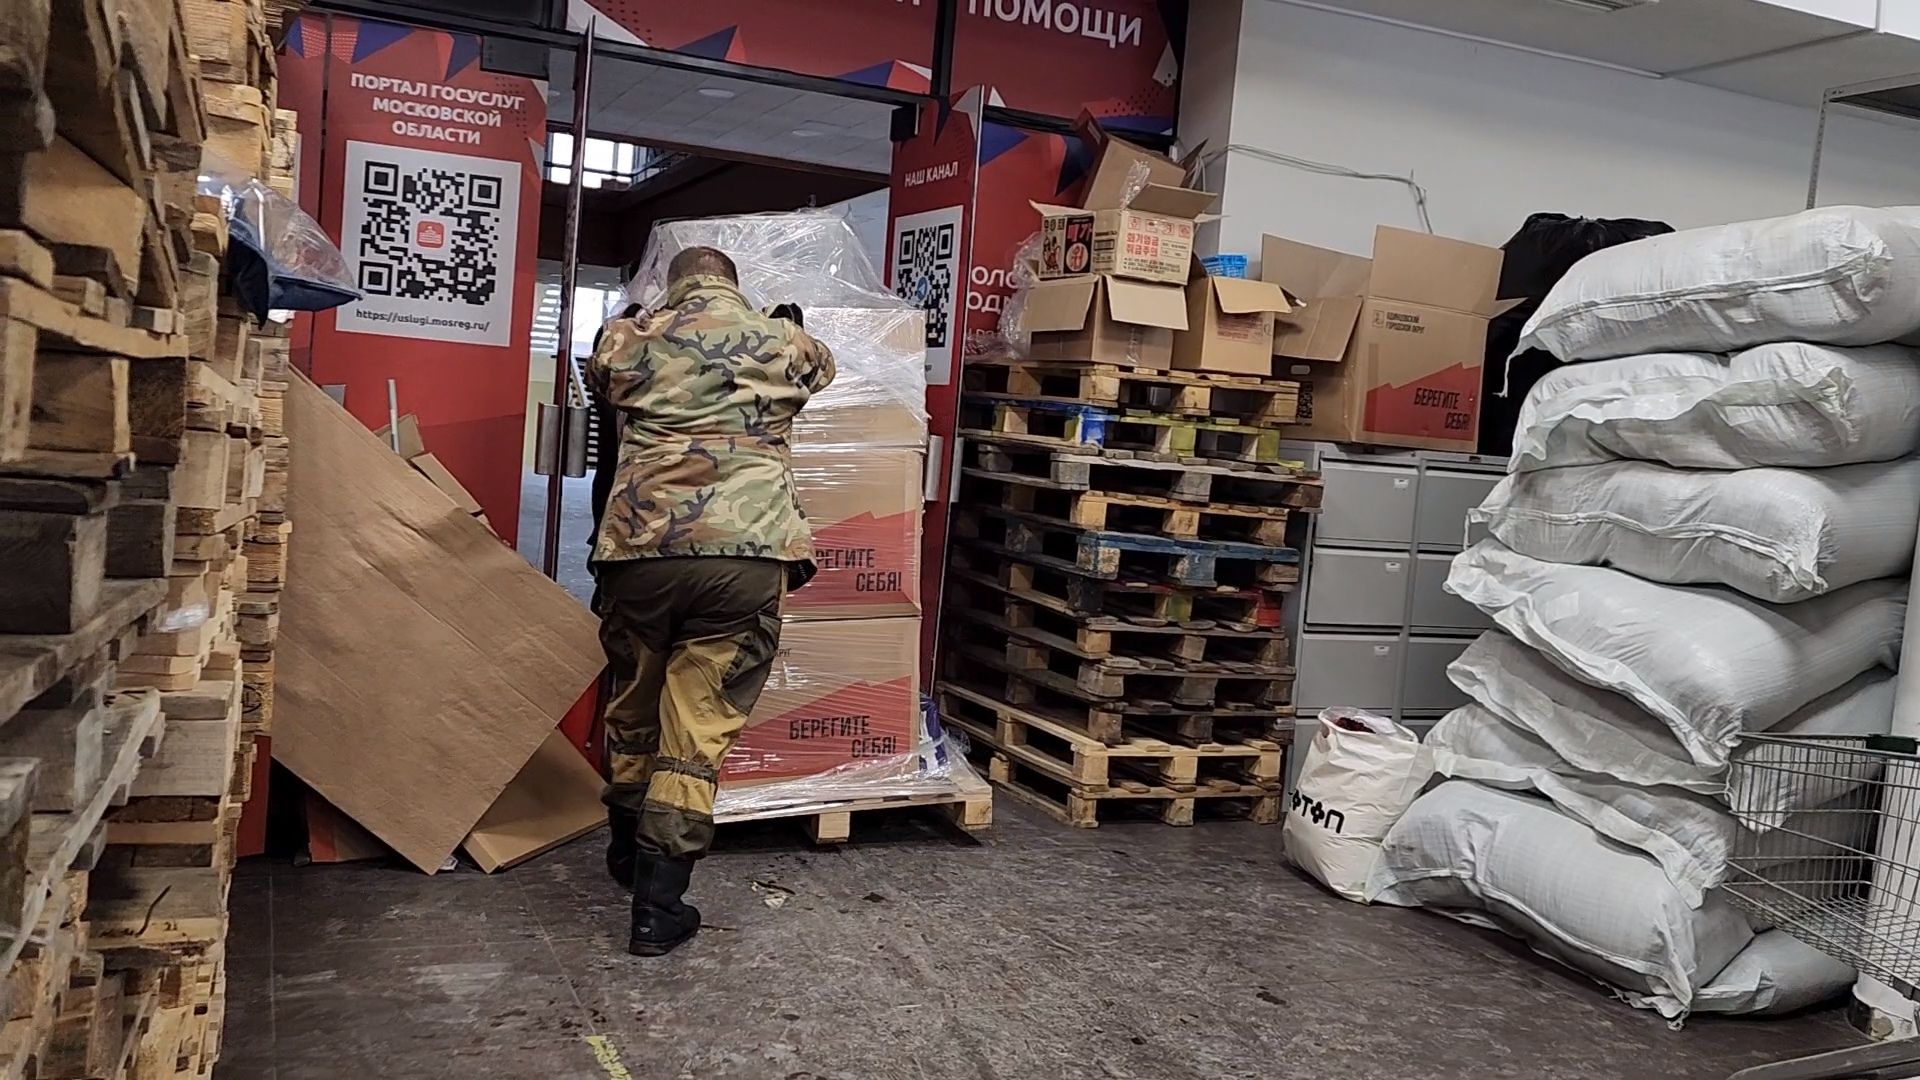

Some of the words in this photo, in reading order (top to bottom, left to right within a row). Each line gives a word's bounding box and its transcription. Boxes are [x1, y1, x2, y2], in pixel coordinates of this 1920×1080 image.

[350, 72, 428, 97] ПОРТАЛ
[430, 84, 526, 110] ГОСУСЛУГ
[372, 97, 502, 127] МОСКОВСКОЙ
[392, 120, 481, 145] ОБЛАСТИ
[904, 169, 925, 187] НАШ
[926, 161, 959, 182] КАНАЛ
[355, 309, 491, 332] https://uslugi.mosreg.ru/
[1414, 387, 1460, 410] БЕРЕГИТЕ
[815, 548, 875, 569] РЕГИТЕ
[856, 571, 902, 592] СЕБЯ!
[789, 715, 871, 740] БЕРЕГИТЕ
[851, 736, 897, 759] СЕБЯ!
